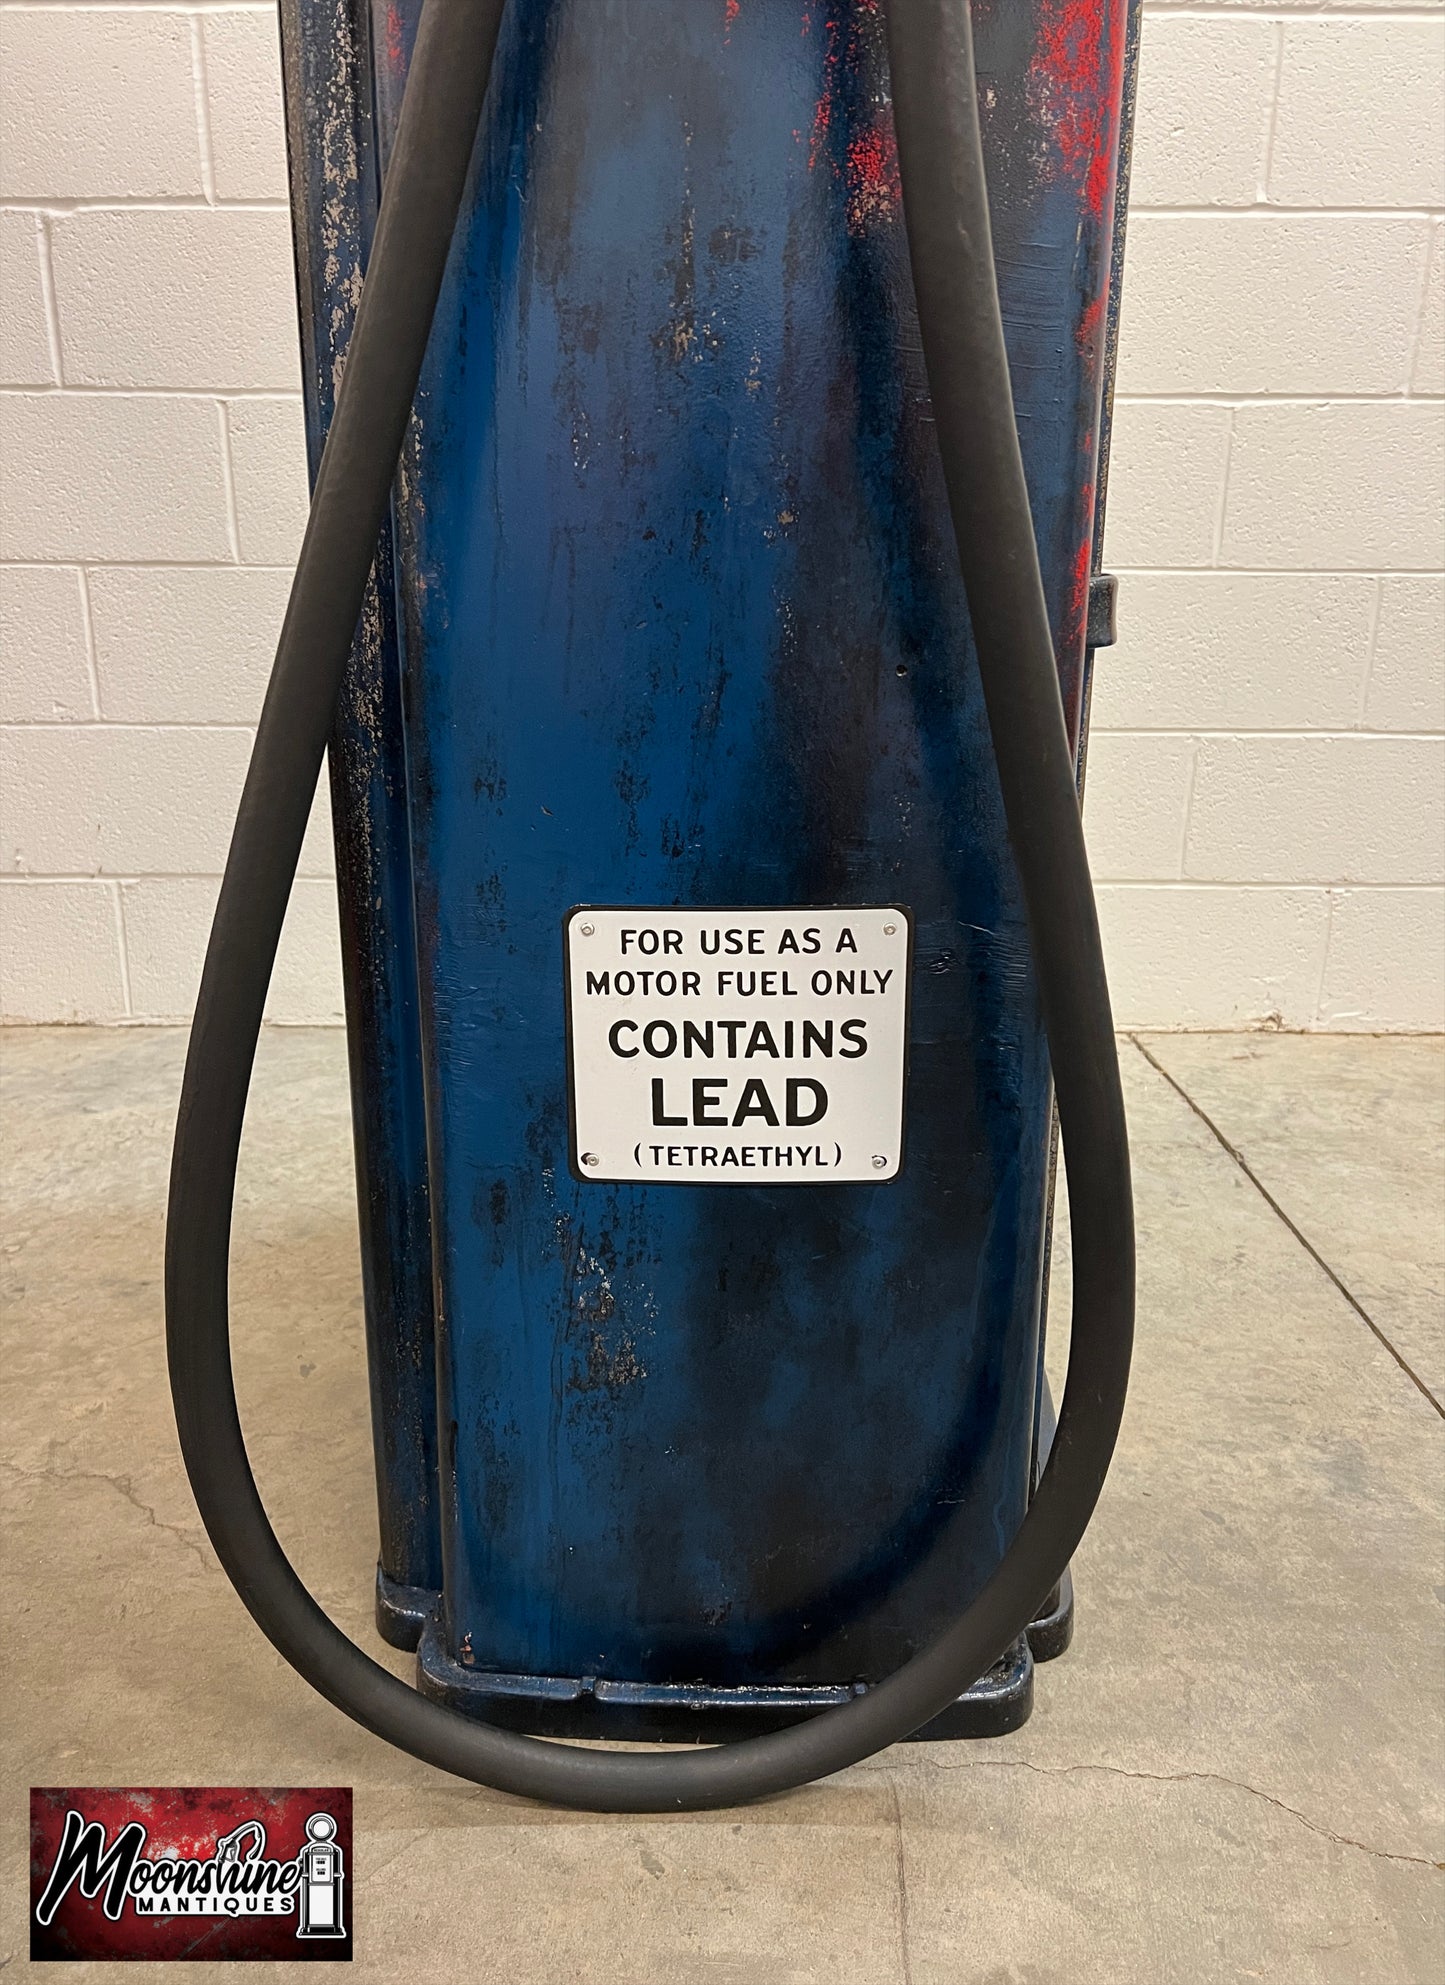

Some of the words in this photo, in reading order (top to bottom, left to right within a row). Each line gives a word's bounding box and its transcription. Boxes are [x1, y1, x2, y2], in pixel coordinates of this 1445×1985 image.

[620, 929, 683, 955] FOR
[700, 928, 765, 955] USE
[777, 927, 821, 954] AS
[835, 927, 858, 954] A
[586, 970, 701, 996] MOTOR
[717, 970, 798, 996] FUEL
[811, 969, 894, 995] ONLY
[608, 1019, 868, 1059] CONTAINS
[651, 1077, 829, 1127] LEAD
[634, 1142, 842, 1168] (TETRAETHYL)
